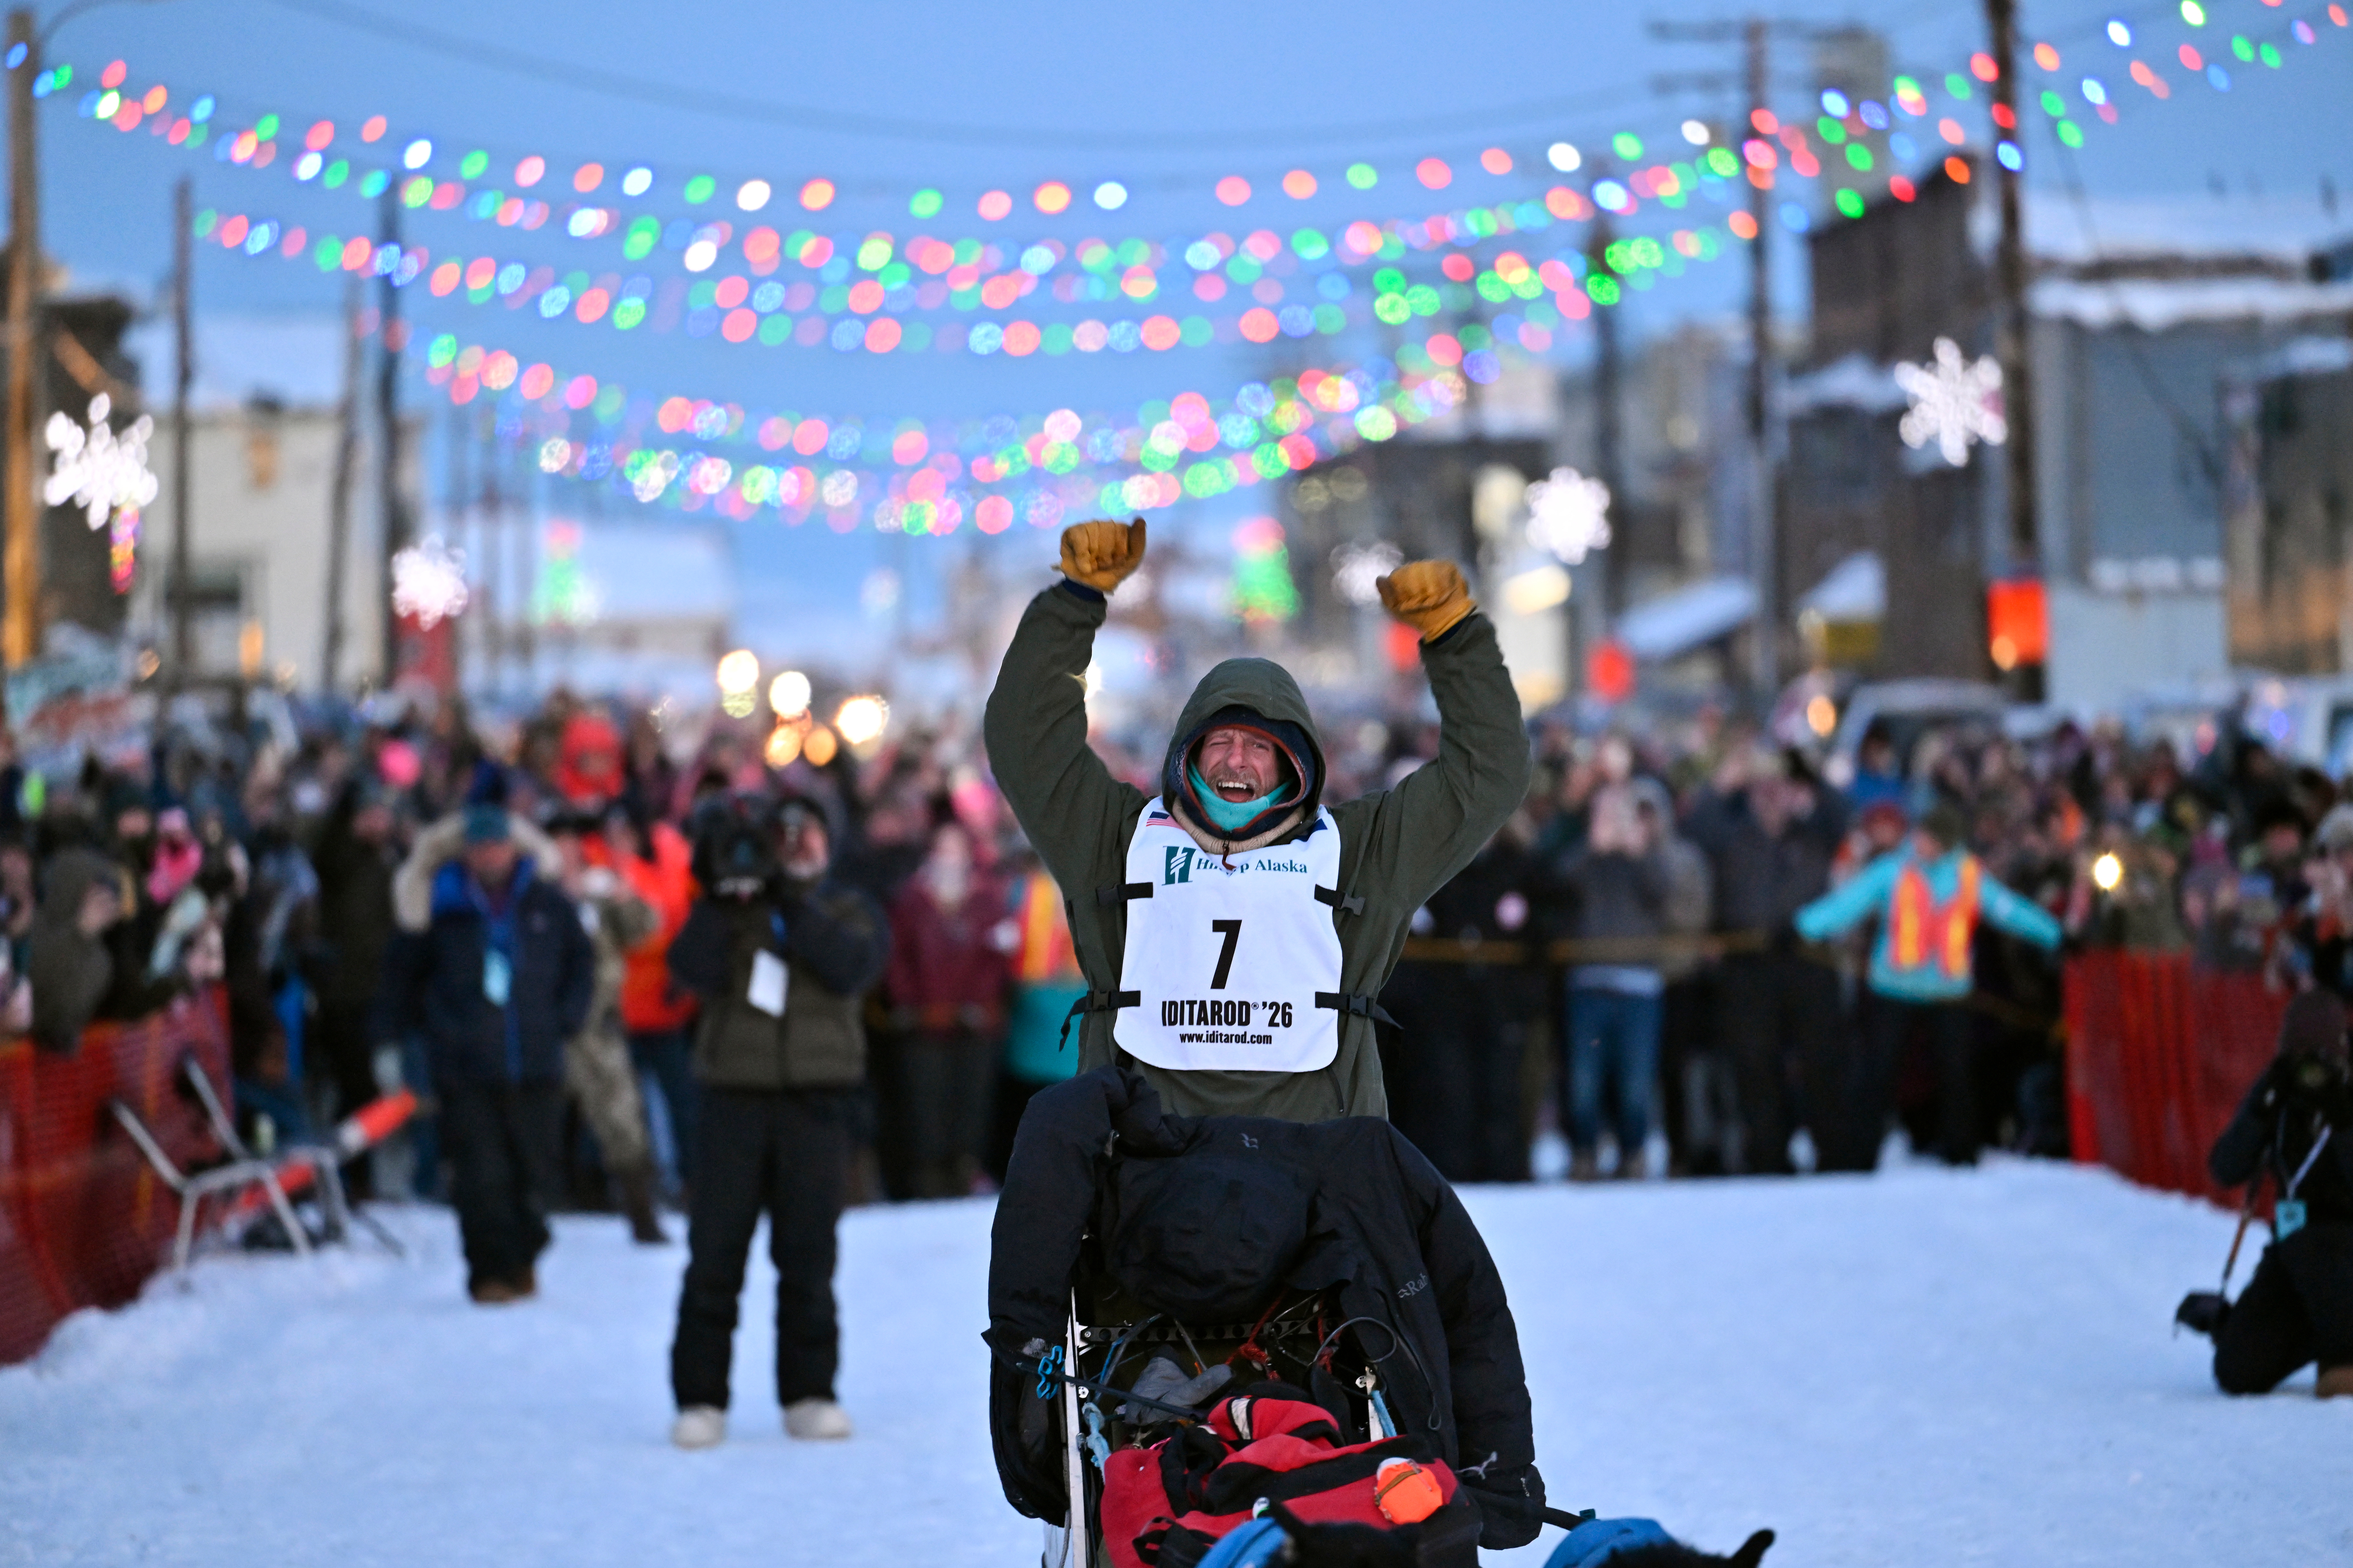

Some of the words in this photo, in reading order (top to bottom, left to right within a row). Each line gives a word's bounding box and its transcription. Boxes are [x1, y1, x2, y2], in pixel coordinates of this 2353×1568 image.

[1255, 859, 1307, 873] Alaska
[1210, 919, 1242, 989] 7
[1179, 1030, 1272, 1045] www.iditarod.com
